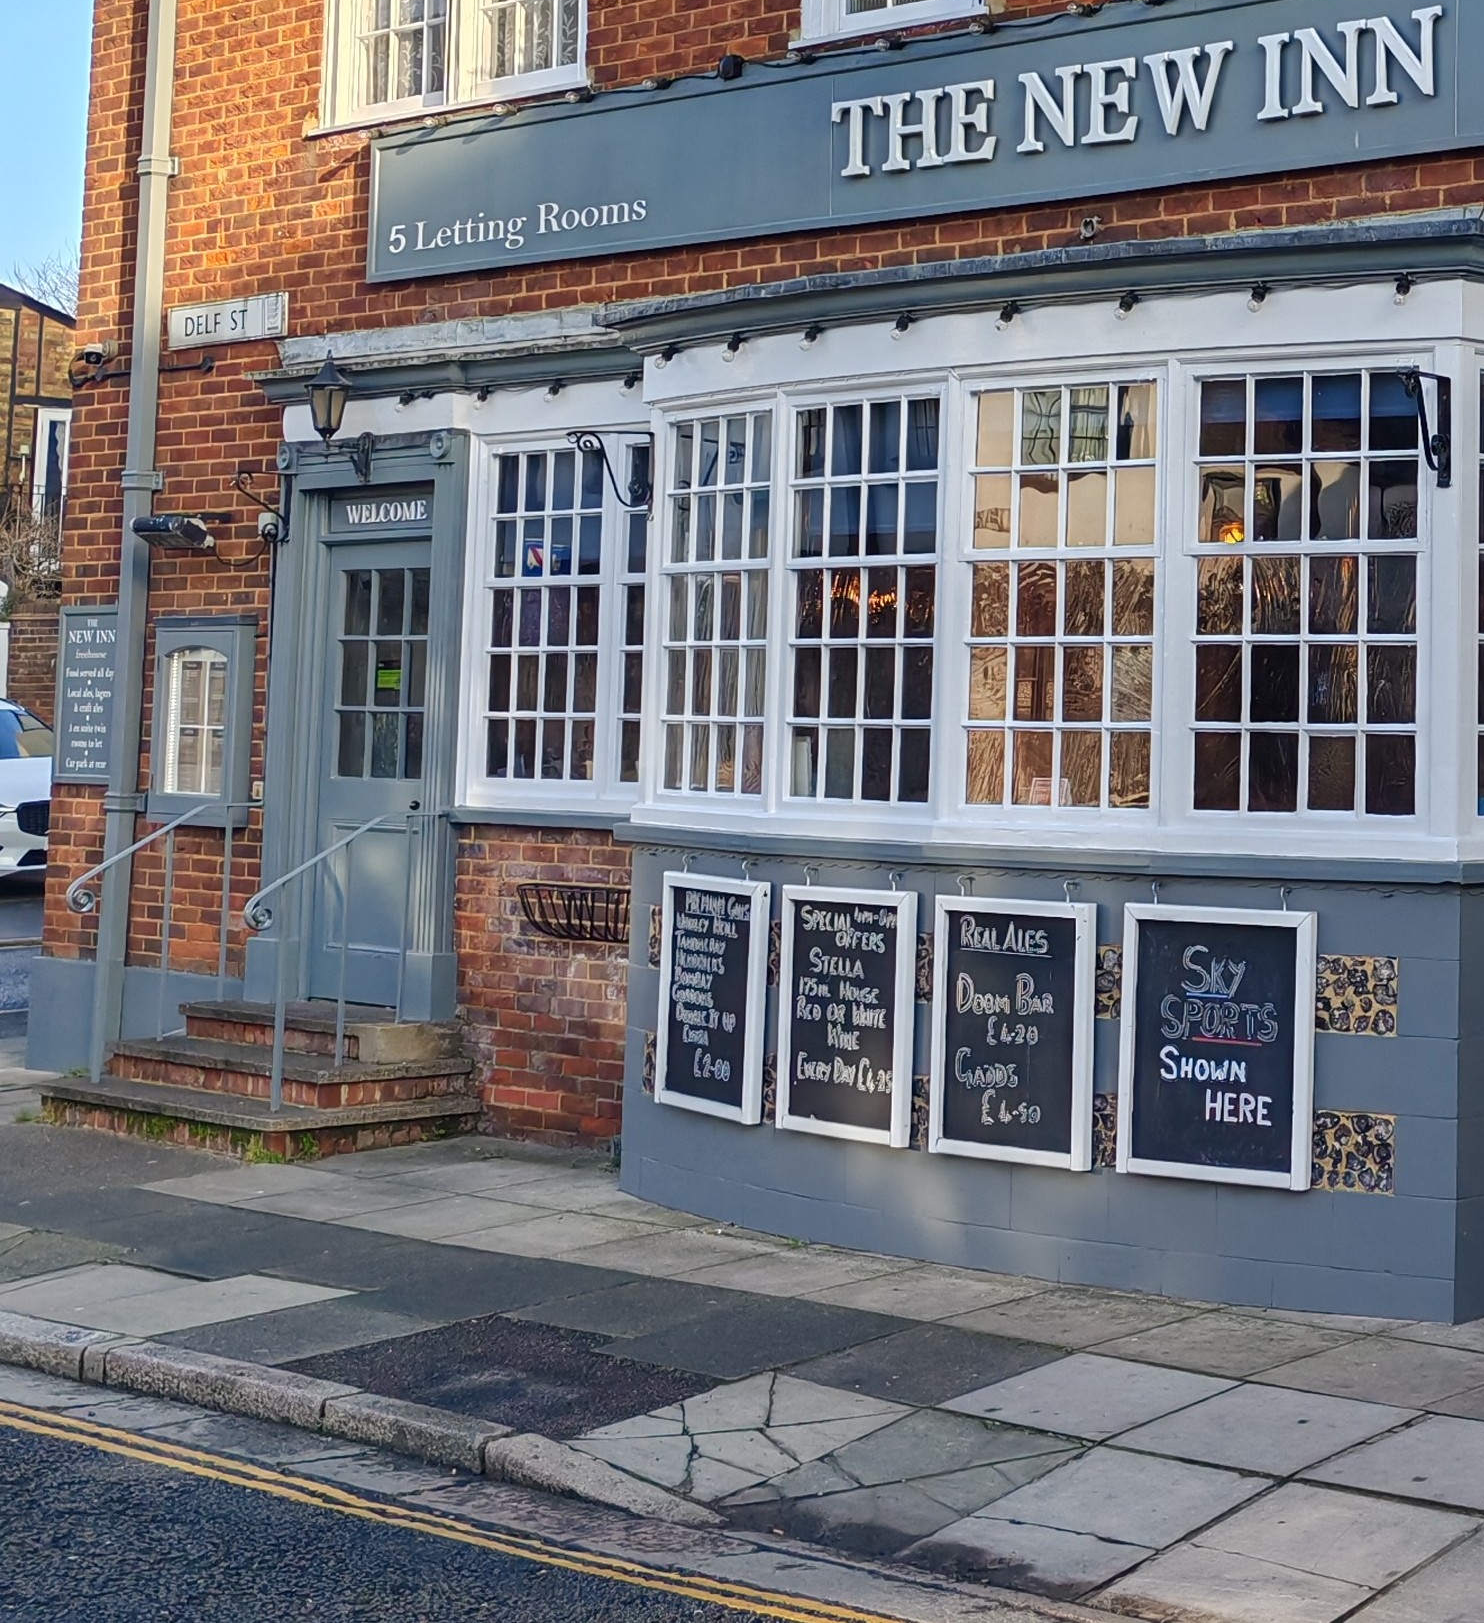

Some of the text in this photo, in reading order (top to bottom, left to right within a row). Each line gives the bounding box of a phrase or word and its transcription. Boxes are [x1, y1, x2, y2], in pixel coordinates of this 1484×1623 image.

[831, 4, 1443, 177] THE NEW INN
[388, 198, 647, 254] 5 Letting Rooms
[184, 309, 248, 337] DELF ST
[345, 499, 428, 524] WELCOME
[68, 629, 116, 644] NEW INN
[87, 618, 98, 627] THE
[75, 648, 107, 659] freehouse
[66, 667, 80, 678] Food
[801, 904, 851, 931] SPECIAL
[835, 928, 885, 954] OFFERS
[960, 914, 1050, 955] REAL ALES
[809, 946, 865, 979] STELLA
[1180, 944, 1247, 999] SKY
[839, 979, 880, 1004] HOUSE
[956, 971, 1055, 1015] DOOM BAR
[796, 994, 887, 1029] RED OR WHITE
[1159, 993, 1279, 1042] SPORTS
[827, 1022, 860, 1051] WINE
[797, 1051, 832, 1083] EVERY
[833, 1056, 856, 1086] DAY
[1158, 1044, 1247, 1083] SHOWN
[1205, 1088, 1273, 1126] HERE
